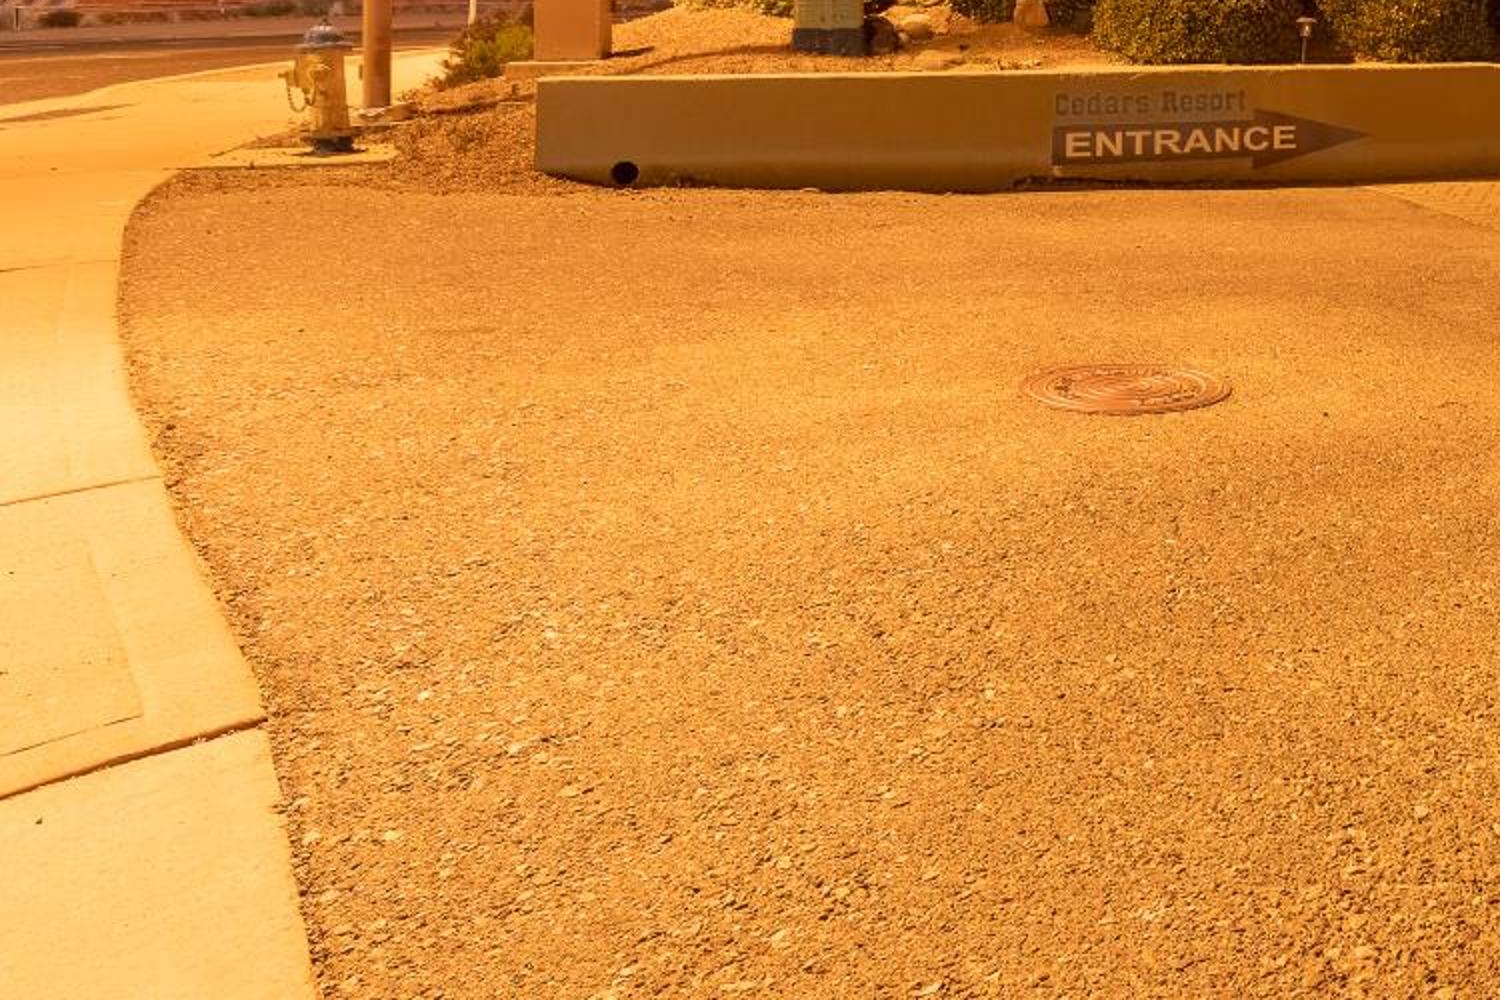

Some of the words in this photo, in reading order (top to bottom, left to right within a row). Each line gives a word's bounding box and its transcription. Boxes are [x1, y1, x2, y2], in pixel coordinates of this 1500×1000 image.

[1055, 92, 1150, 117] Cedars
[1161, 89, 1247, 114] Resort
[1065, 125, 1297, 158] ENTRANCE
